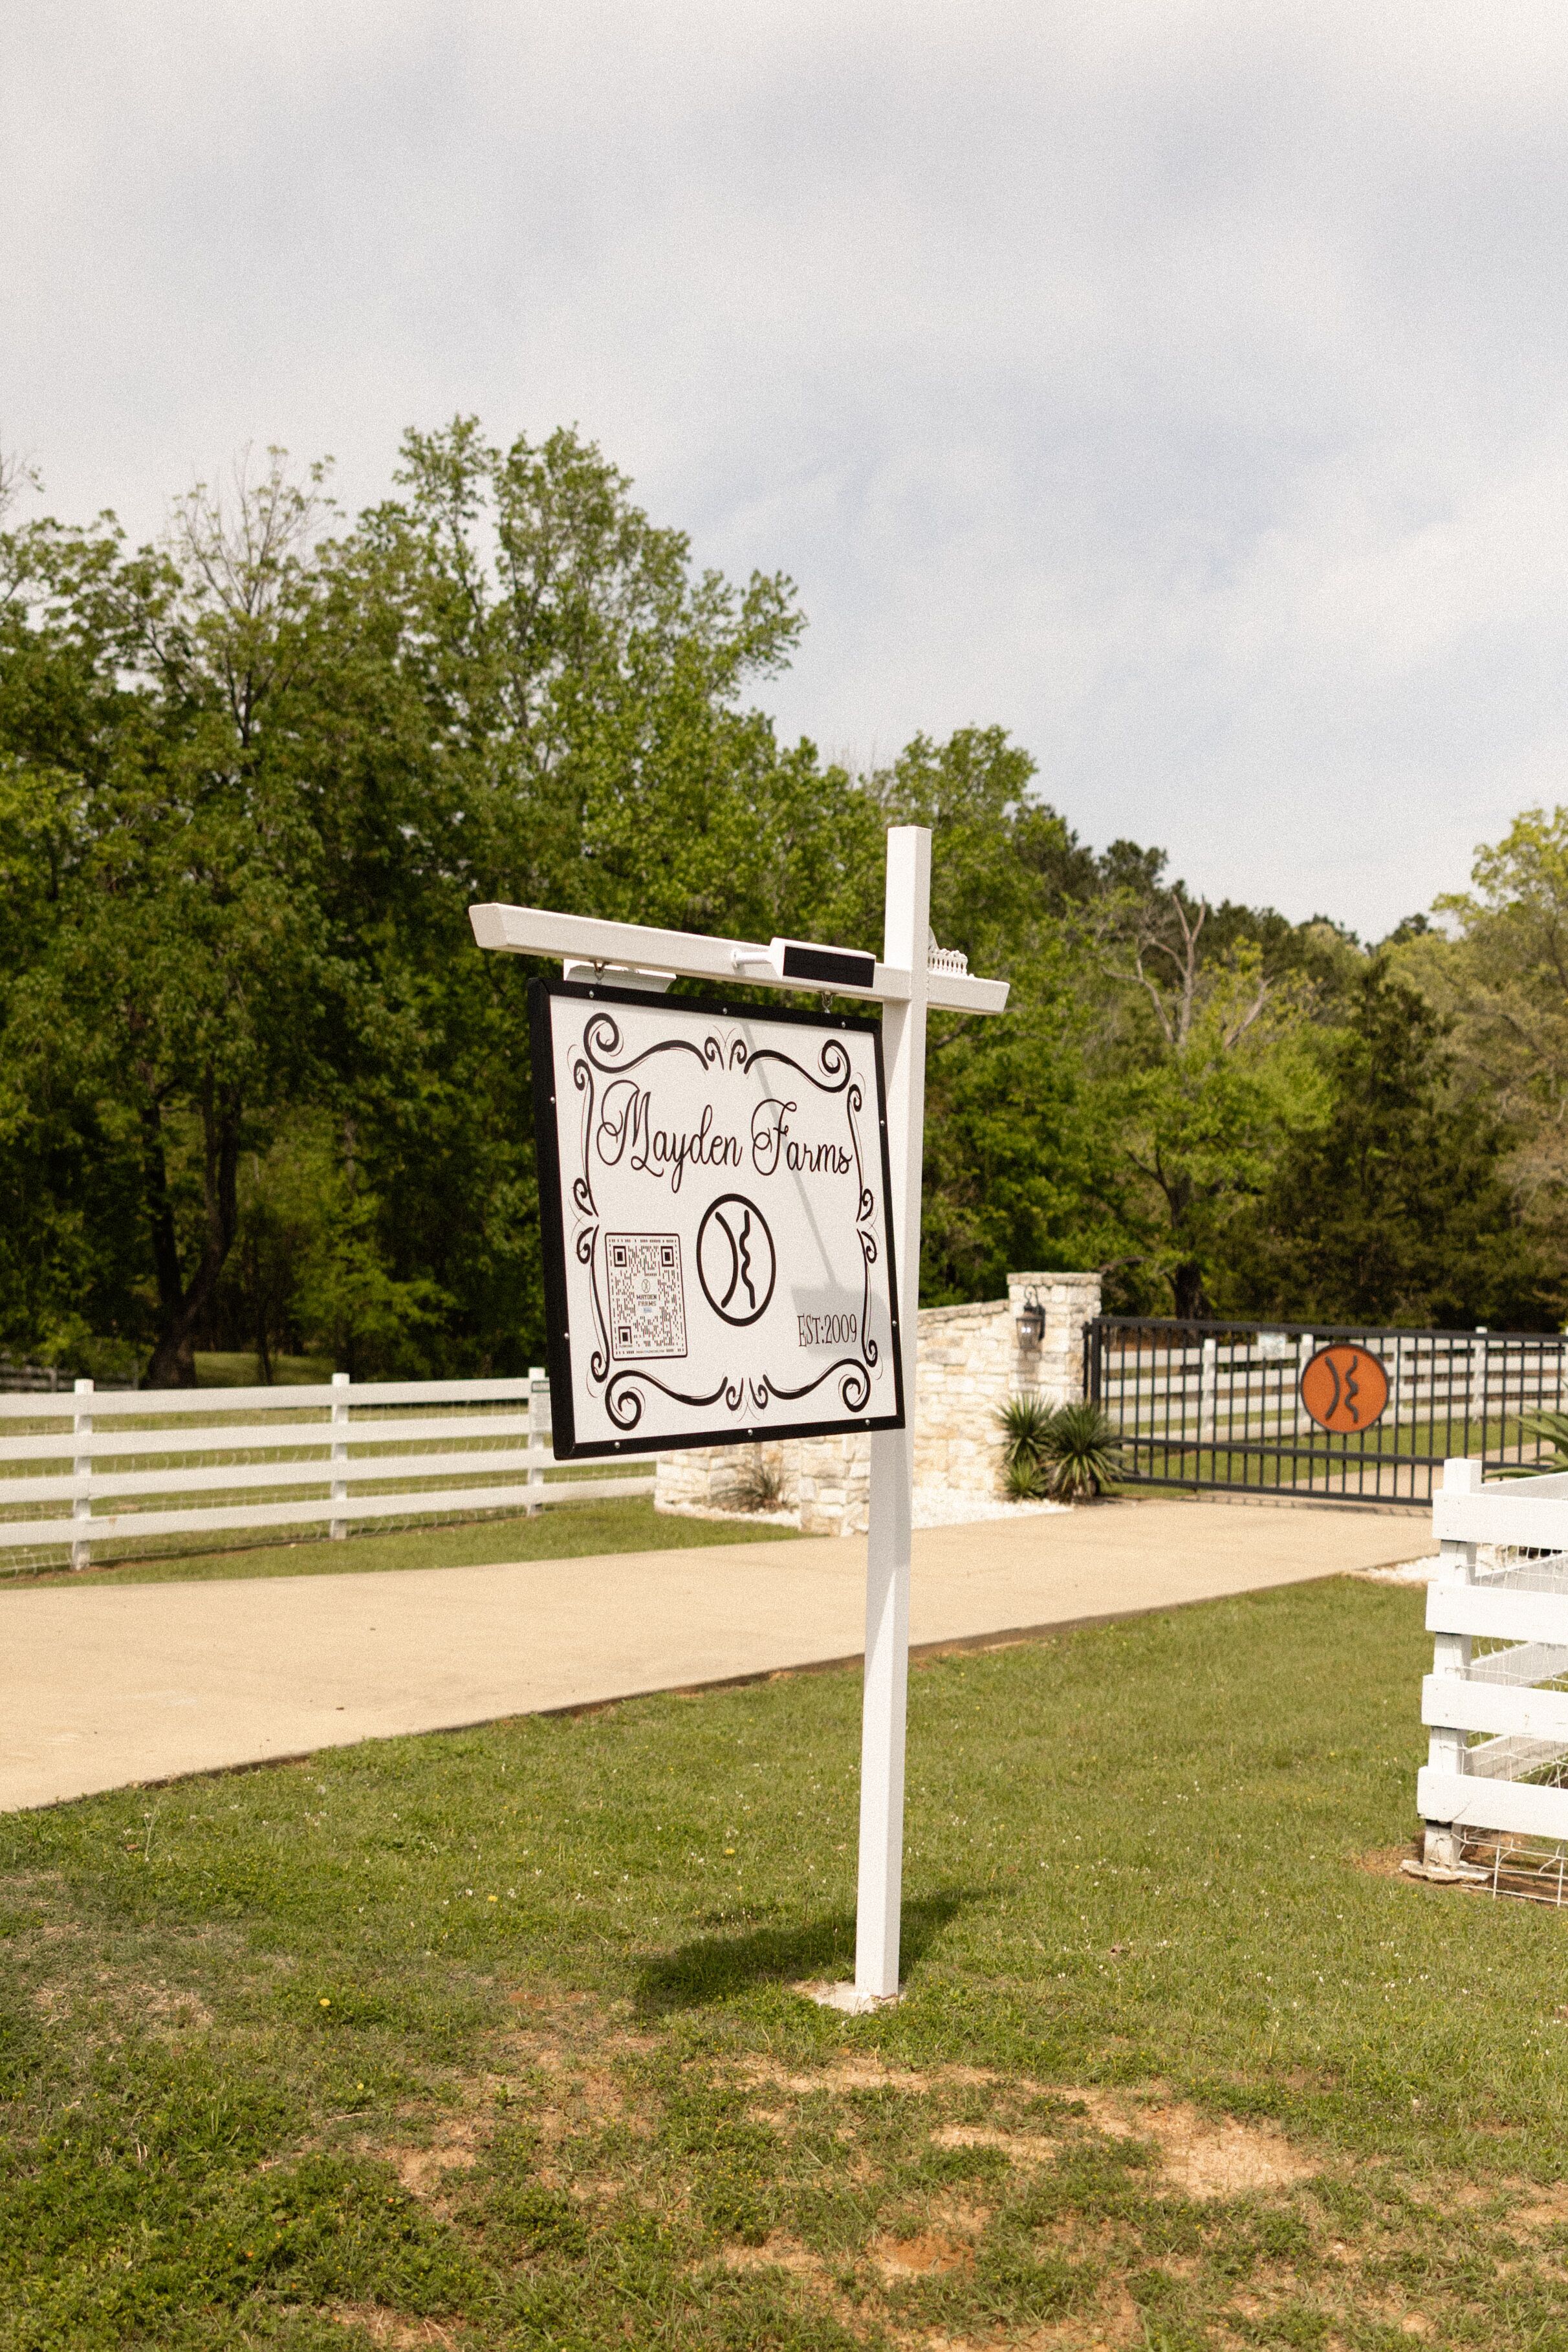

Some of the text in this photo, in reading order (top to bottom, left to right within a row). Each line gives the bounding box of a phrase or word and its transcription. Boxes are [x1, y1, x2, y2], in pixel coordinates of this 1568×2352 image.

[596, 1080, 853, 1193] Mayden Farms
[797, 1313, 857, 1347] EST:2009
